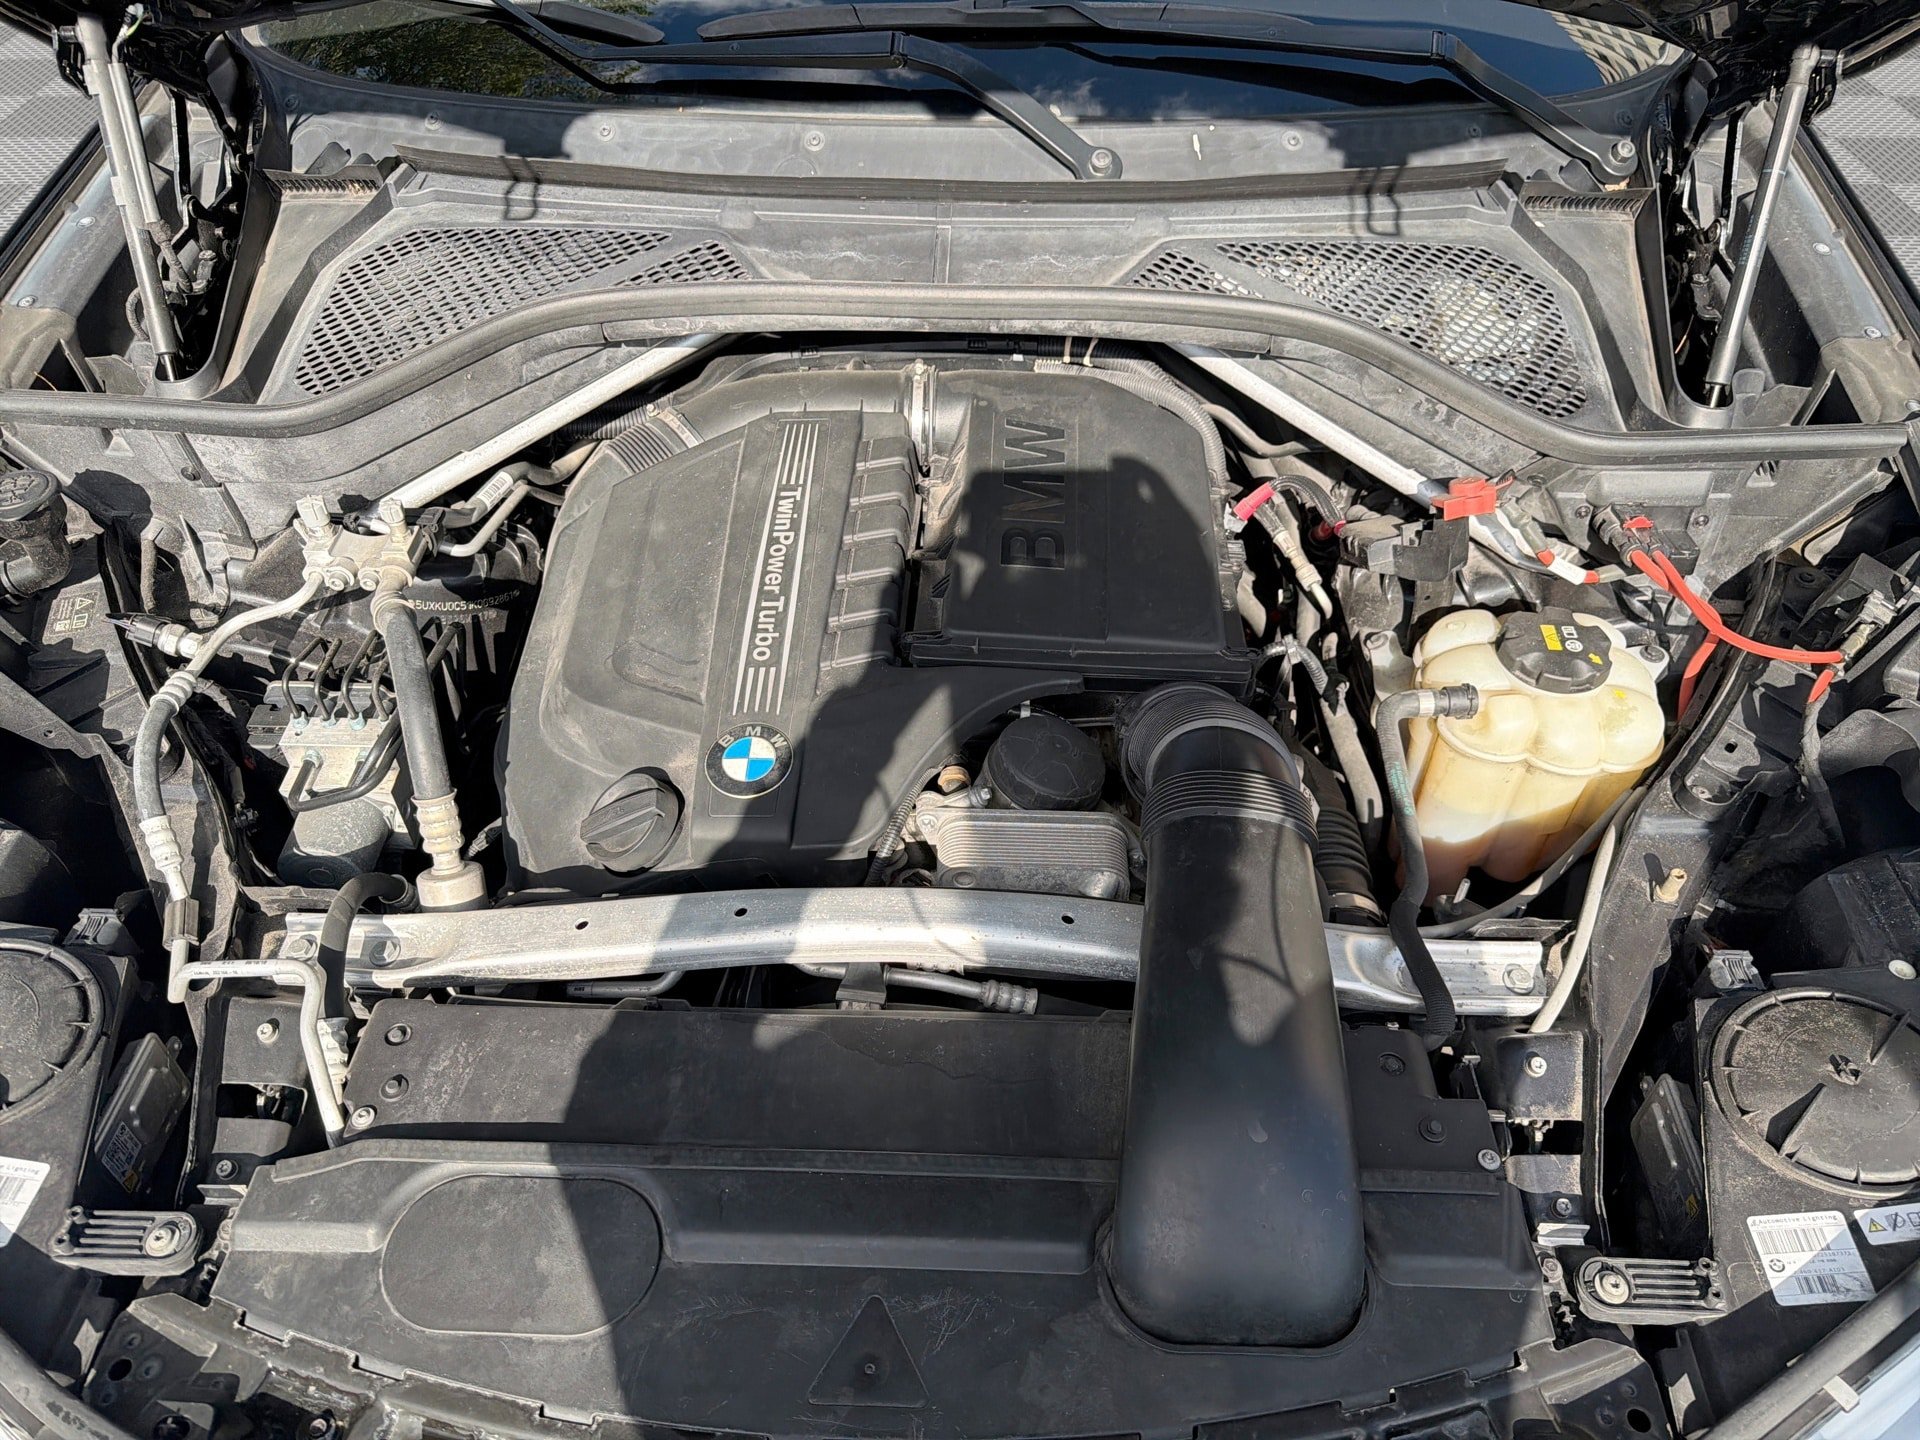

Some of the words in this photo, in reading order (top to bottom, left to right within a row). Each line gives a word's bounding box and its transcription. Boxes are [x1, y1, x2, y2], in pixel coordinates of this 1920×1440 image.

[1001, 417, 1066, 570] BMW
[763, 487, 802, 594] TwinPower
[752, 596, 785, 661] Turbo
[718, 726, 787, 748] BMW
[1803, 1214, 1838, 1222] Lighting
